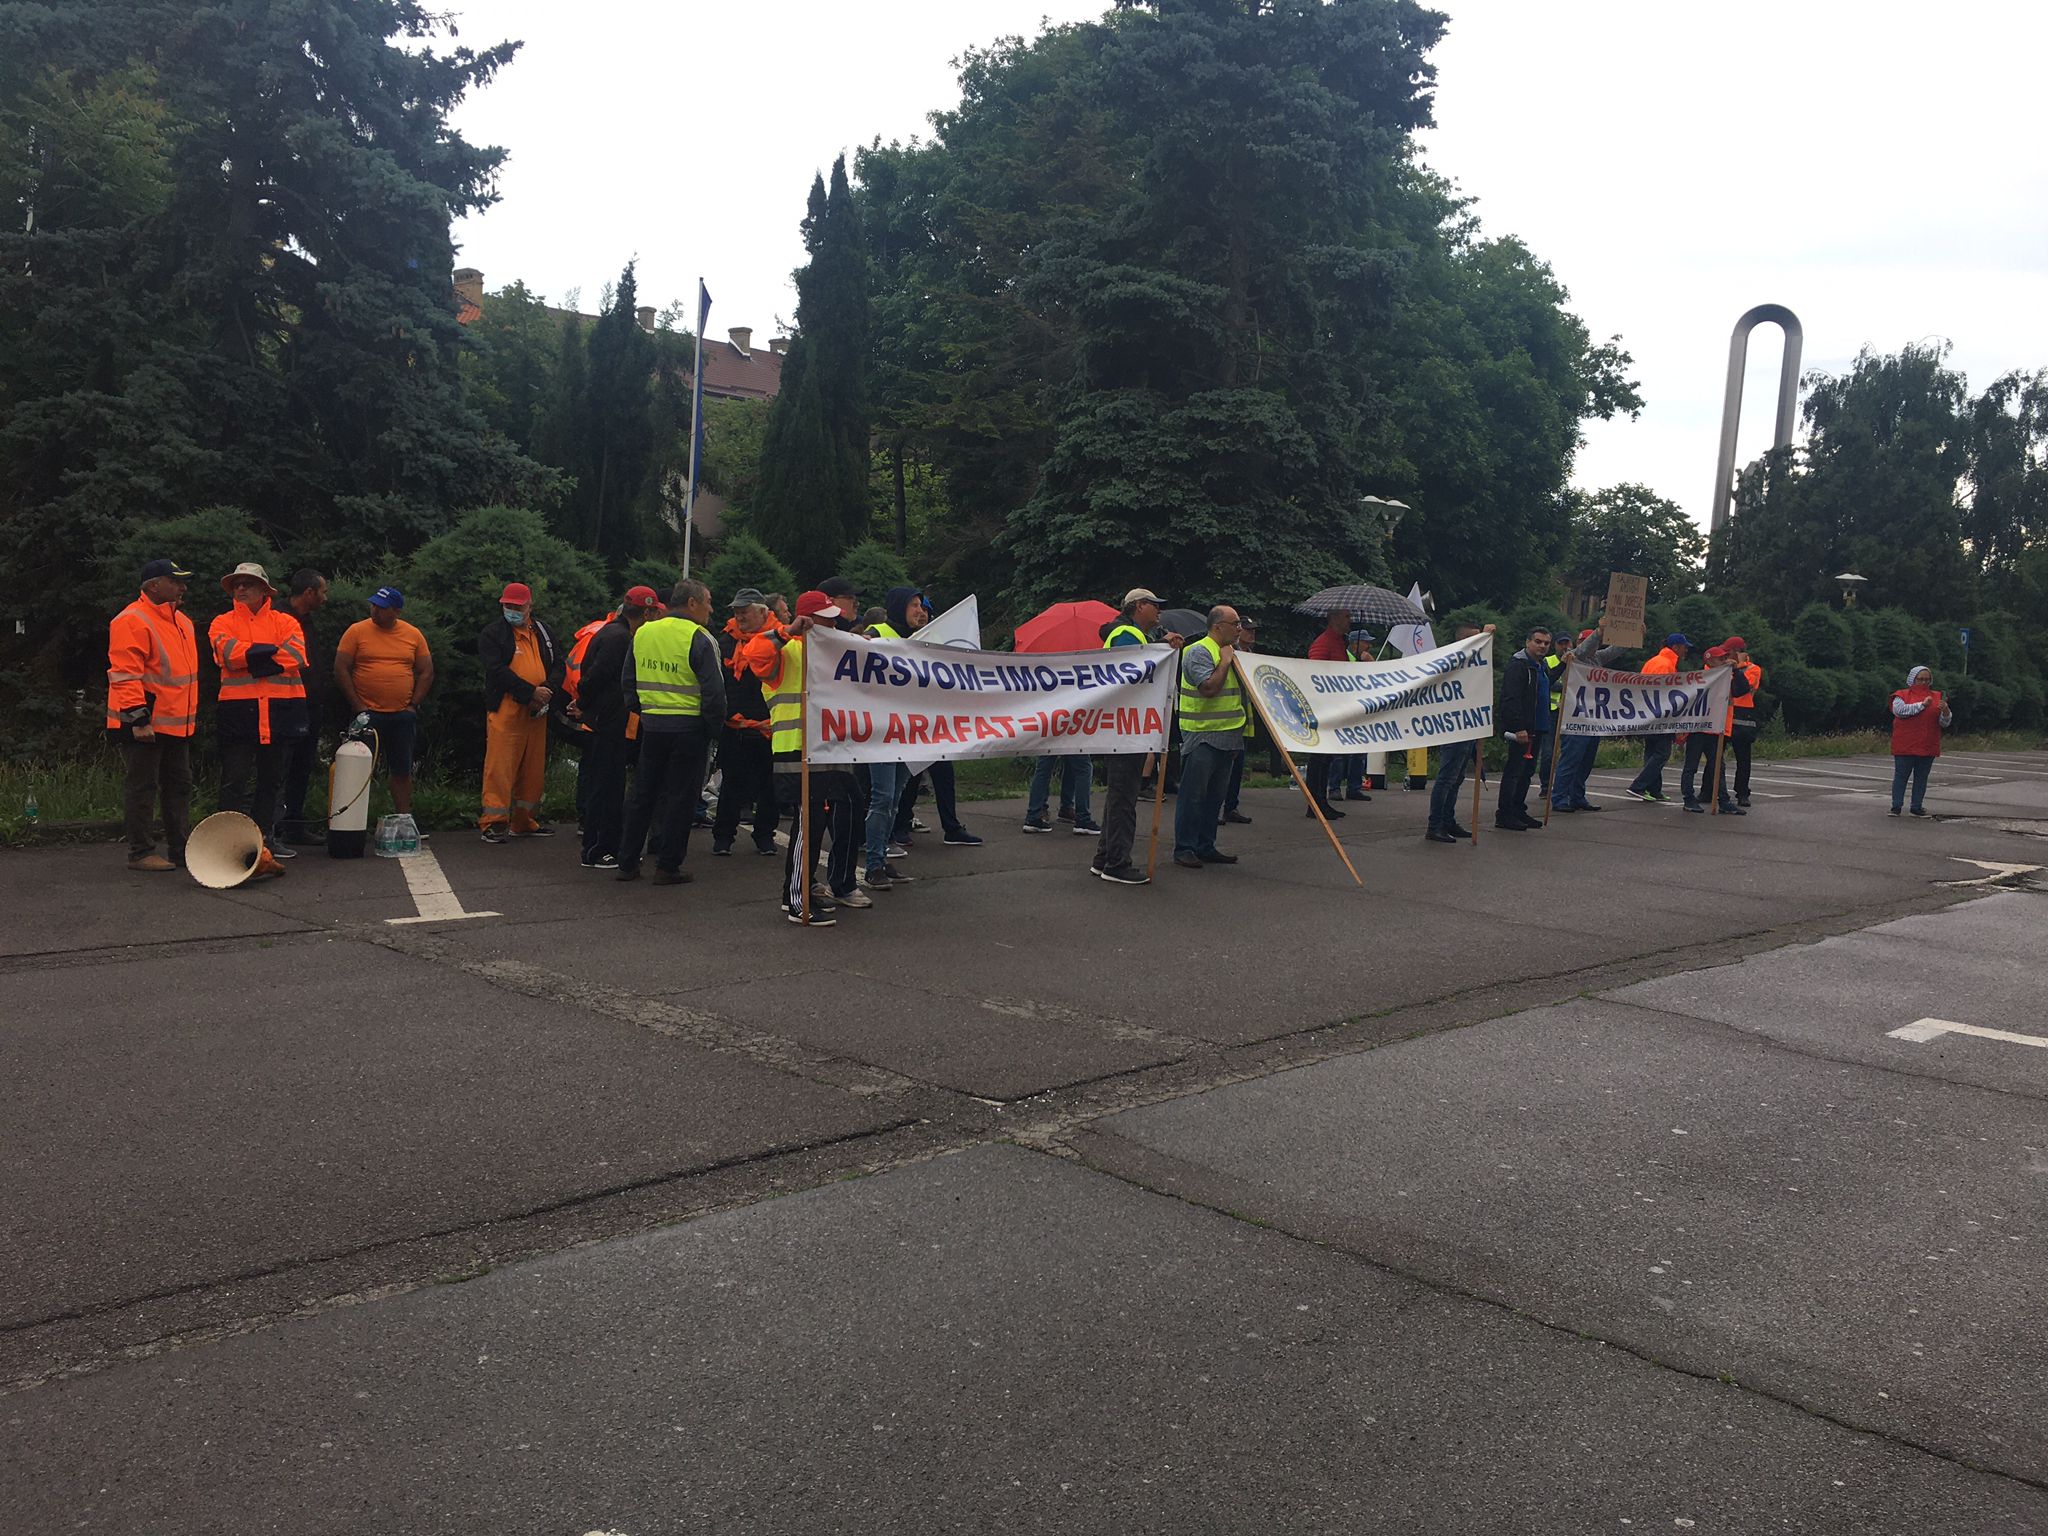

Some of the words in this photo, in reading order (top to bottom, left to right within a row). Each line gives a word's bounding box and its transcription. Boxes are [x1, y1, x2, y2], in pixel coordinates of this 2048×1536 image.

[641, 658, 679, 673] ARSVOM
[834, 649, 1156, 692] ARSVOM=IMO=EMSA
[1310, 668, 1415, 694] SINDICATUL
[1417, 648, 1488, 676] LIBERAL
[1587, 668, 1609, 683] JOS
[1664, 673, 1683, 685] DE
[1686, 671, 1706, 685] PE
[1357, 679, 1466, 714] MARINARILOR
[1572, 686, 1710, 720] A.R.S.V.O.M.
[821, 707, 873, 743] NU
[883, 706, 1166, 744] ARAFAT=IGSU=MA
[1334, 720, 1403, 746] ARSVOM
